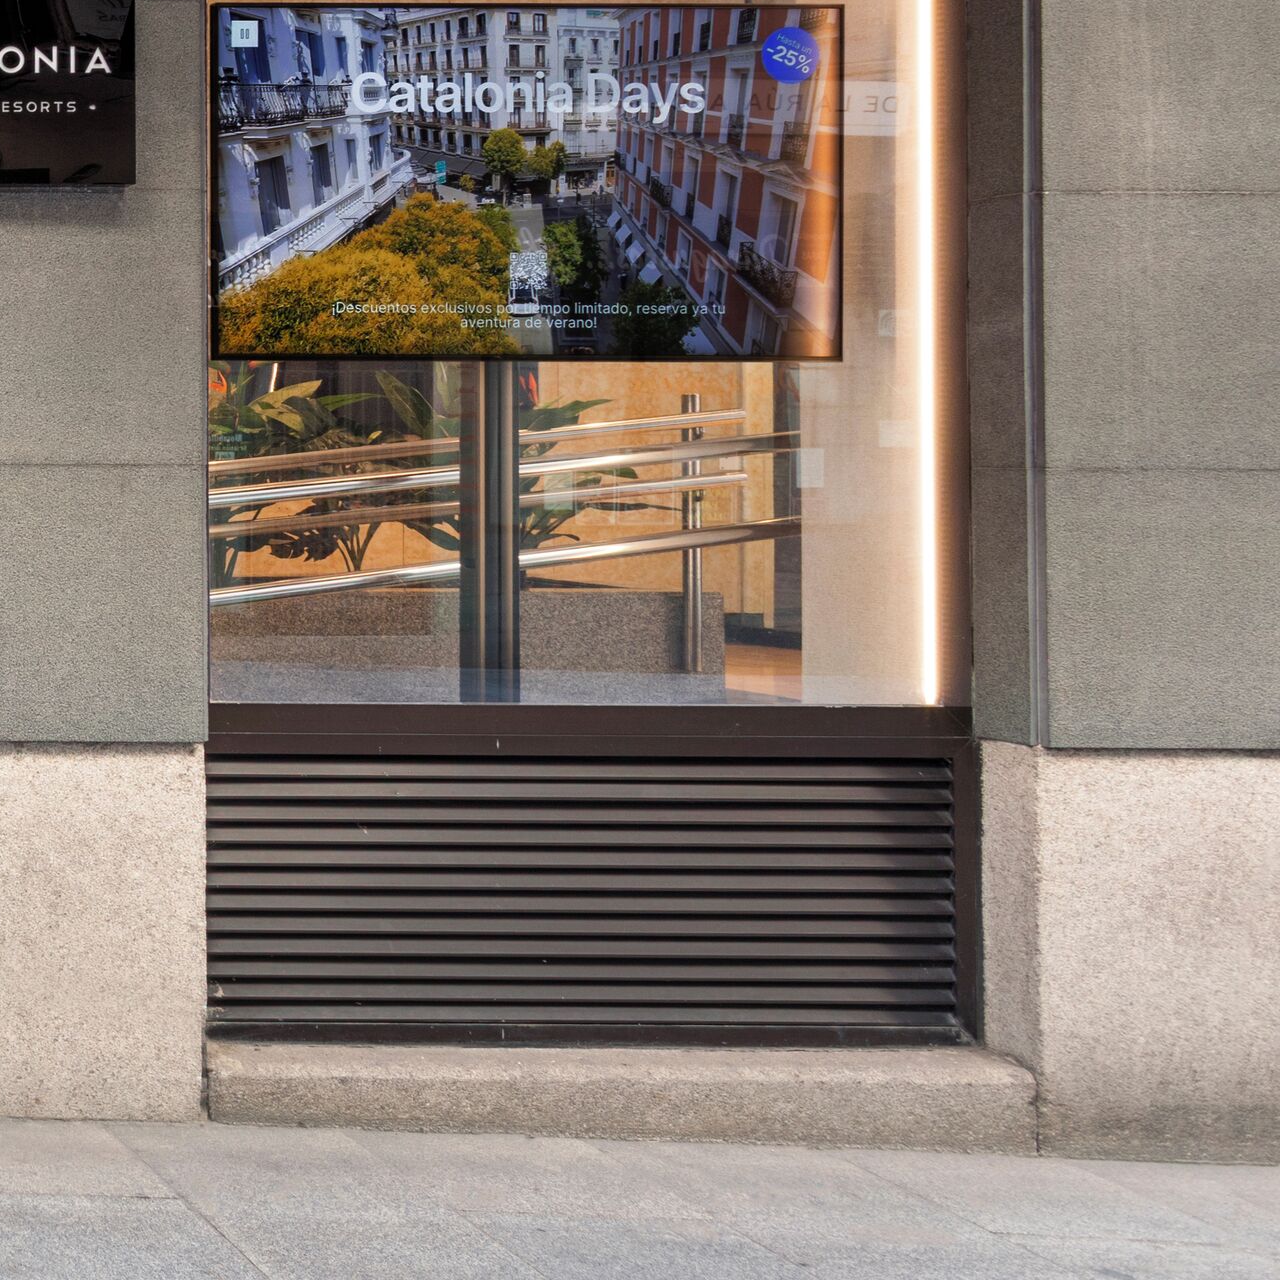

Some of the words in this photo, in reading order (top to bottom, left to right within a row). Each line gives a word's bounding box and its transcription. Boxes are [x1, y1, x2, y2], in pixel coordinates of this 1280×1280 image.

[766, 45, 813, 74] -25%
[351, 70, 573, 114] Catalonia
[587, 72, 706, 124] Days
[331, 301, 417, 316] ¡Descuentos
[420, 301, 493, 315] exclusivos
[496, 304, 520, 318] por
[574, 301, 633, 317] limitado,
[636, 304, 688, 315] reserva
[692, 304, 709, 318] ya
[712, 302, 727, 315] tu
[460, 318, 521, 329] aventura
[524, 317, 542, 329] de
[546, 317, 598, 329] verano!
